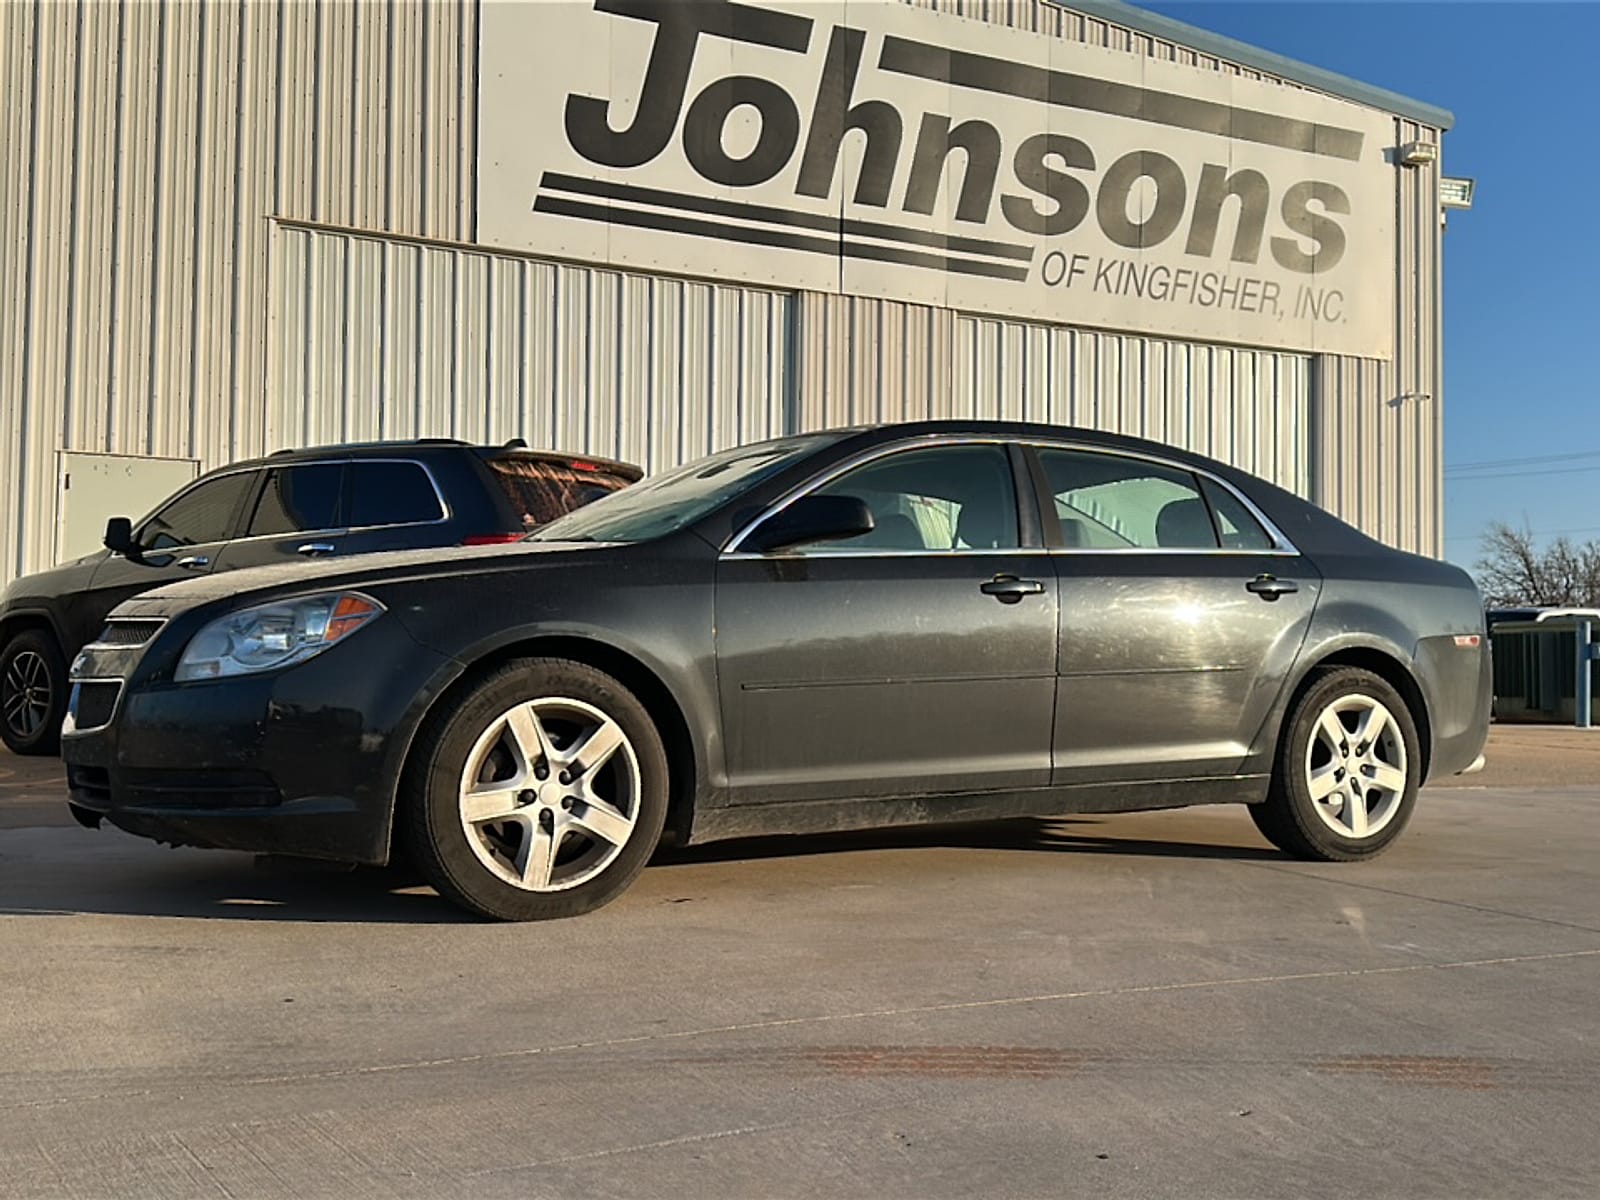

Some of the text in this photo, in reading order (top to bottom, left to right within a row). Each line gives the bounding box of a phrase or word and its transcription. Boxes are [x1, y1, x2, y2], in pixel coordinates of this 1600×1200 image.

[564, 0, 1351, 274] Johnsons
[1041, 251, 1347, 324] OF KINGFISHER, INC.
